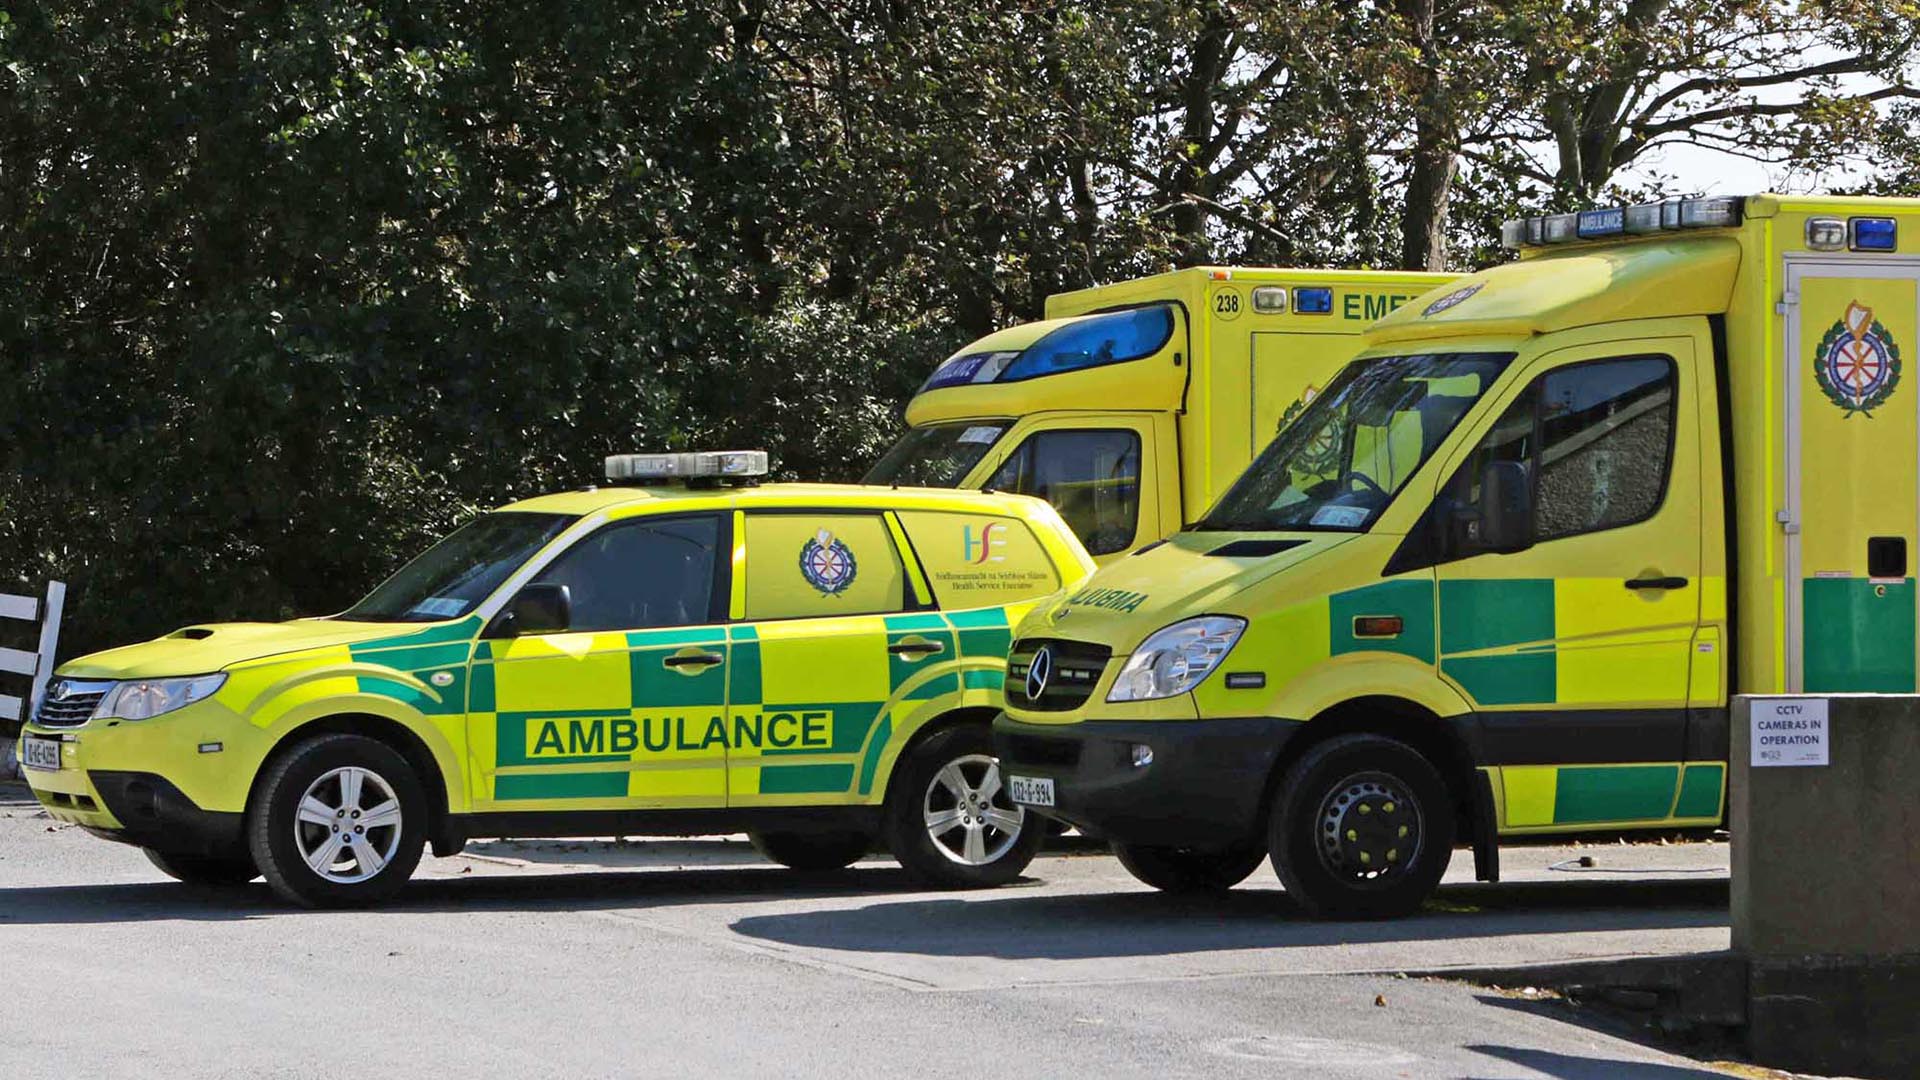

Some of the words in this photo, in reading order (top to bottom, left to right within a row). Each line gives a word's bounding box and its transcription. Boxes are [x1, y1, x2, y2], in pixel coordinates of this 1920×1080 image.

[1579, 211, 1623, 230] AMBULANCE
[1216, 294, 1239, 312] 238
[1343, 294, 1419, 320] EME
[963, 521, 1008, 565] HSE
[952, 581, 975, 590] Health
[976, 581, 1000, 590] Service
[1776, 705, 1803, 715] CCTV
[532, 712, 828, 755] AMBULANCE
[1758, 720, 1808, 730] CAMERAS
[1810, 720, 1822, 729] IN
[1760, 735, 1819, 745] OPERATION
